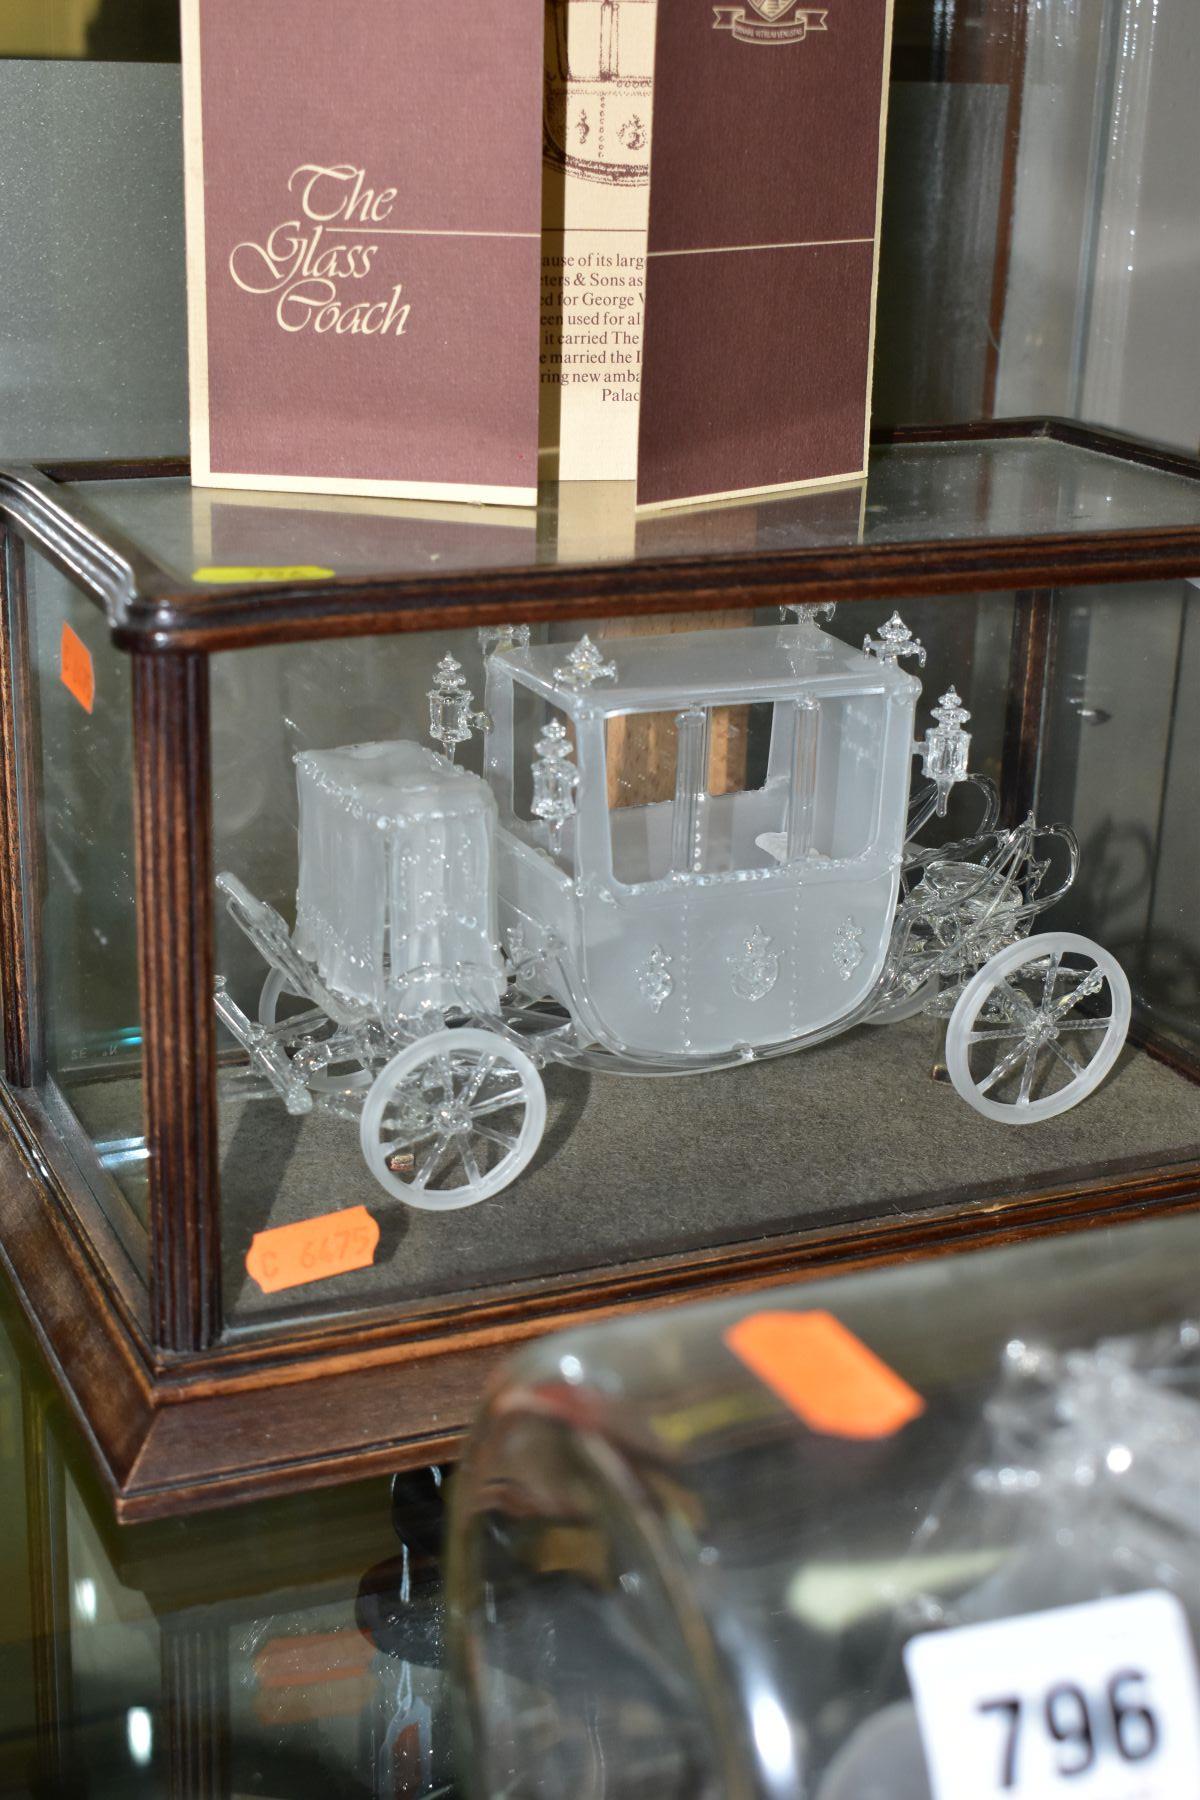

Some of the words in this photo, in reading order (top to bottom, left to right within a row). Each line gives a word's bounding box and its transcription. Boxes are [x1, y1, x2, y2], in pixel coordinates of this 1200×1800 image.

[288, 164, 398, 222] The
[229, 220, 379, 294] Glass
[578, 253, 593, 267] of
[596, 253, 613, 267] its
[574, 273, 586, 287] &
[590, 273, 625, 287] Sons
[628, 277, 643, 287] as
[276, 277, 411, 336] Coach
[557, 292, 578, 306] for
[582, 292, 634, 309] George
[568, 312, 599, 325] used
[603, 312, 624, 325] for
[545, 332, 554, 345] it
[558, 331, 608, 345] carried
[611, 331, 640, 345] The
[550, 350, 606, 364] married
[611, 350, 632, 364] the
[572, 373, 600, 383] new
[977, 1668, 1159, 1788] 796
